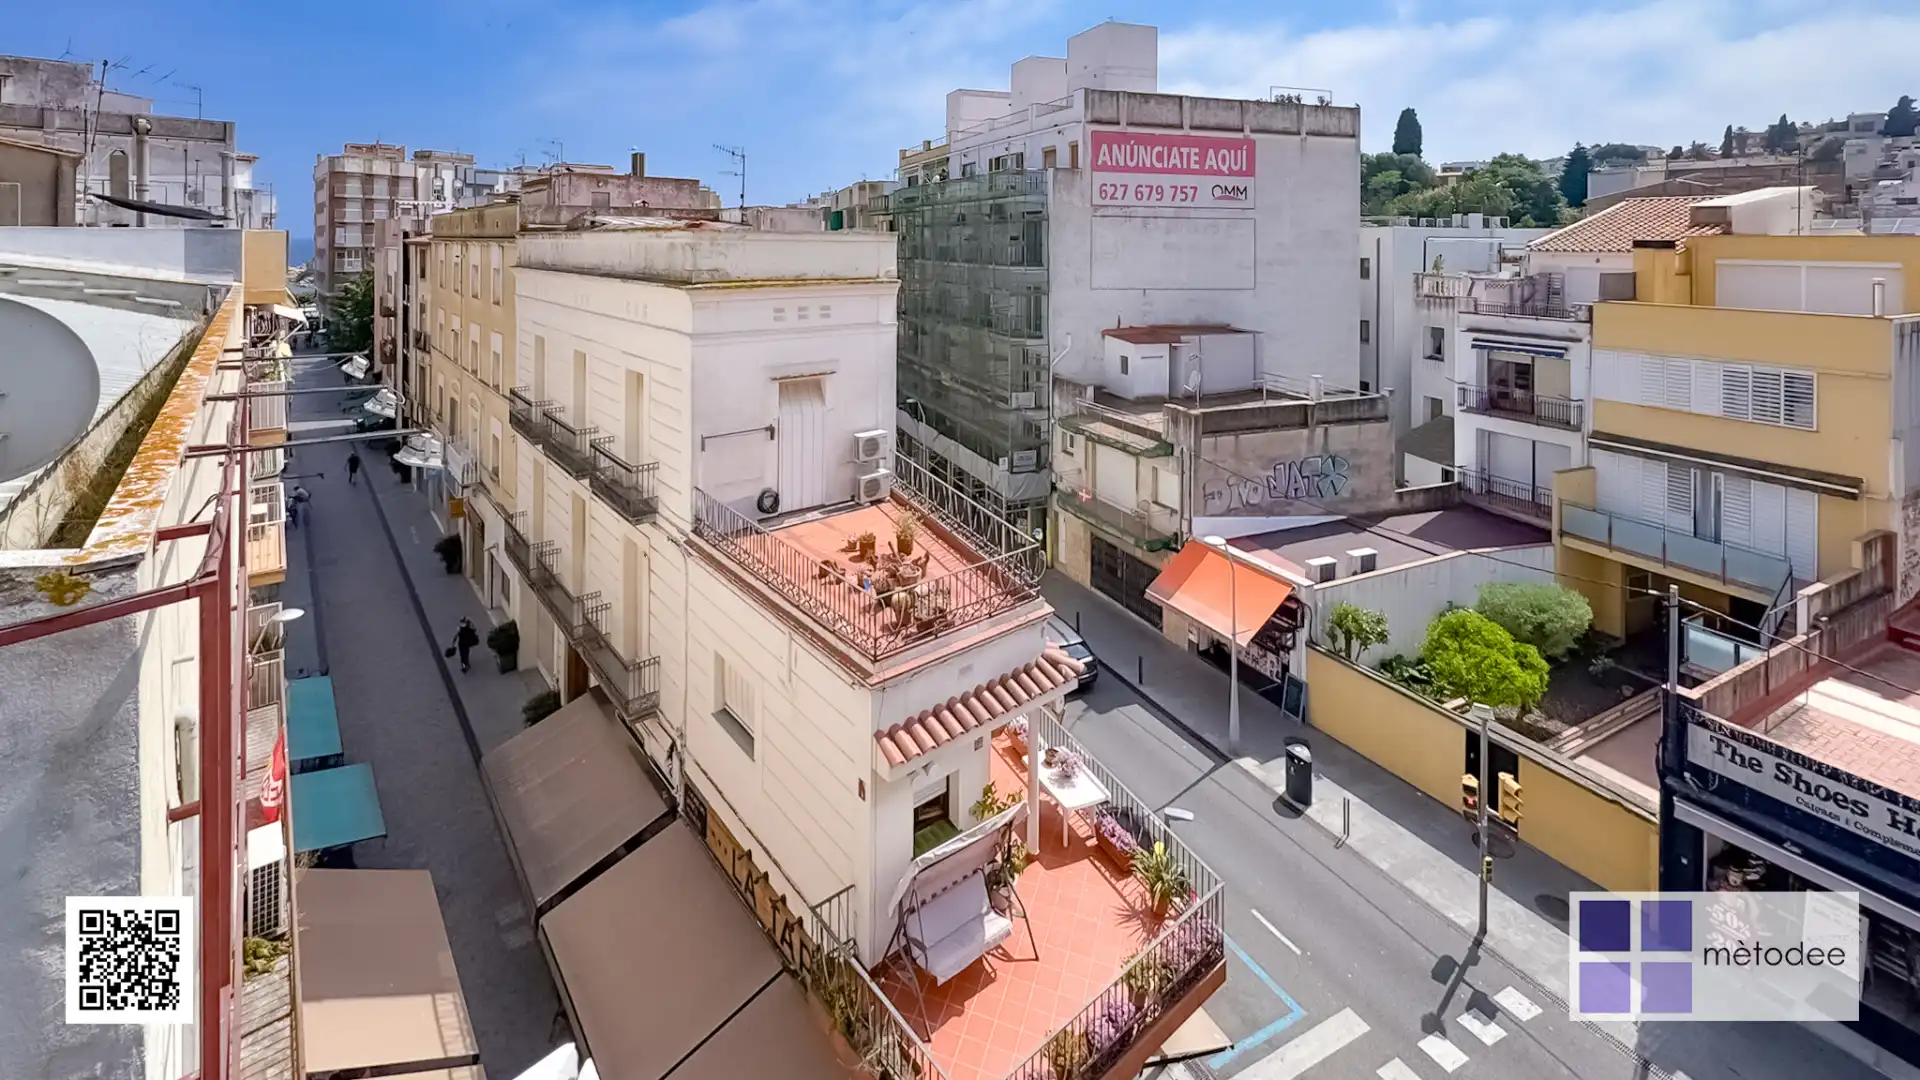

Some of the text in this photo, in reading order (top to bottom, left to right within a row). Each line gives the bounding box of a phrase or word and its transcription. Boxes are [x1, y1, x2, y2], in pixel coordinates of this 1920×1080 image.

[1098, 140, 1248, 175] ANÚNCIATE AQUÍ
[1099, 183, 1198, 203] 627 679 757
[1709, 734, 1764, 774] The
[1773, 761, 1869, 819] Shoes
